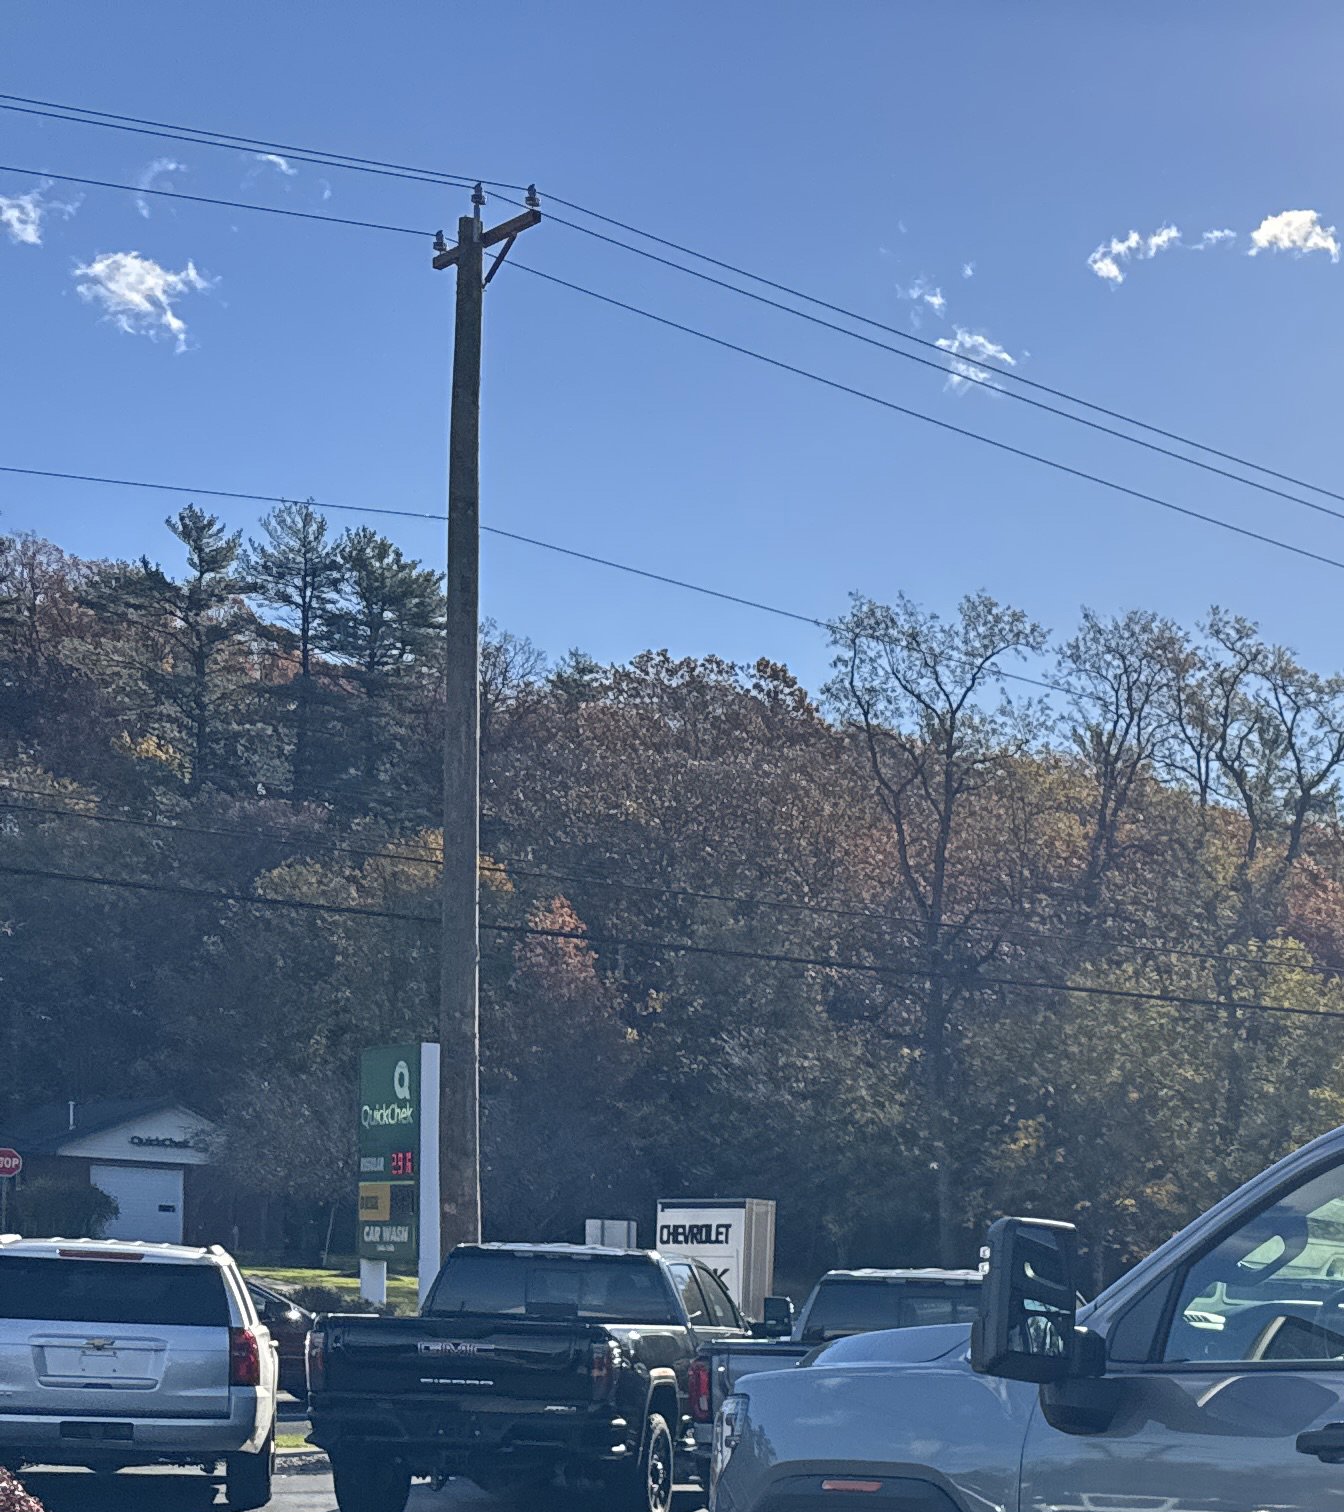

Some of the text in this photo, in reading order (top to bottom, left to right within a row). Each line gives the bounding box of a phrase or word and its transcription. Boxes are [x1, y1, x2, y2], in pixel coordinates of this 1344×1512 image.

[361, 1102, 414, 1129] QuickChek
[363, 1226, 409, 1242] CAR WASH
[659, 1223, 733, 1245] CHEVROLET
